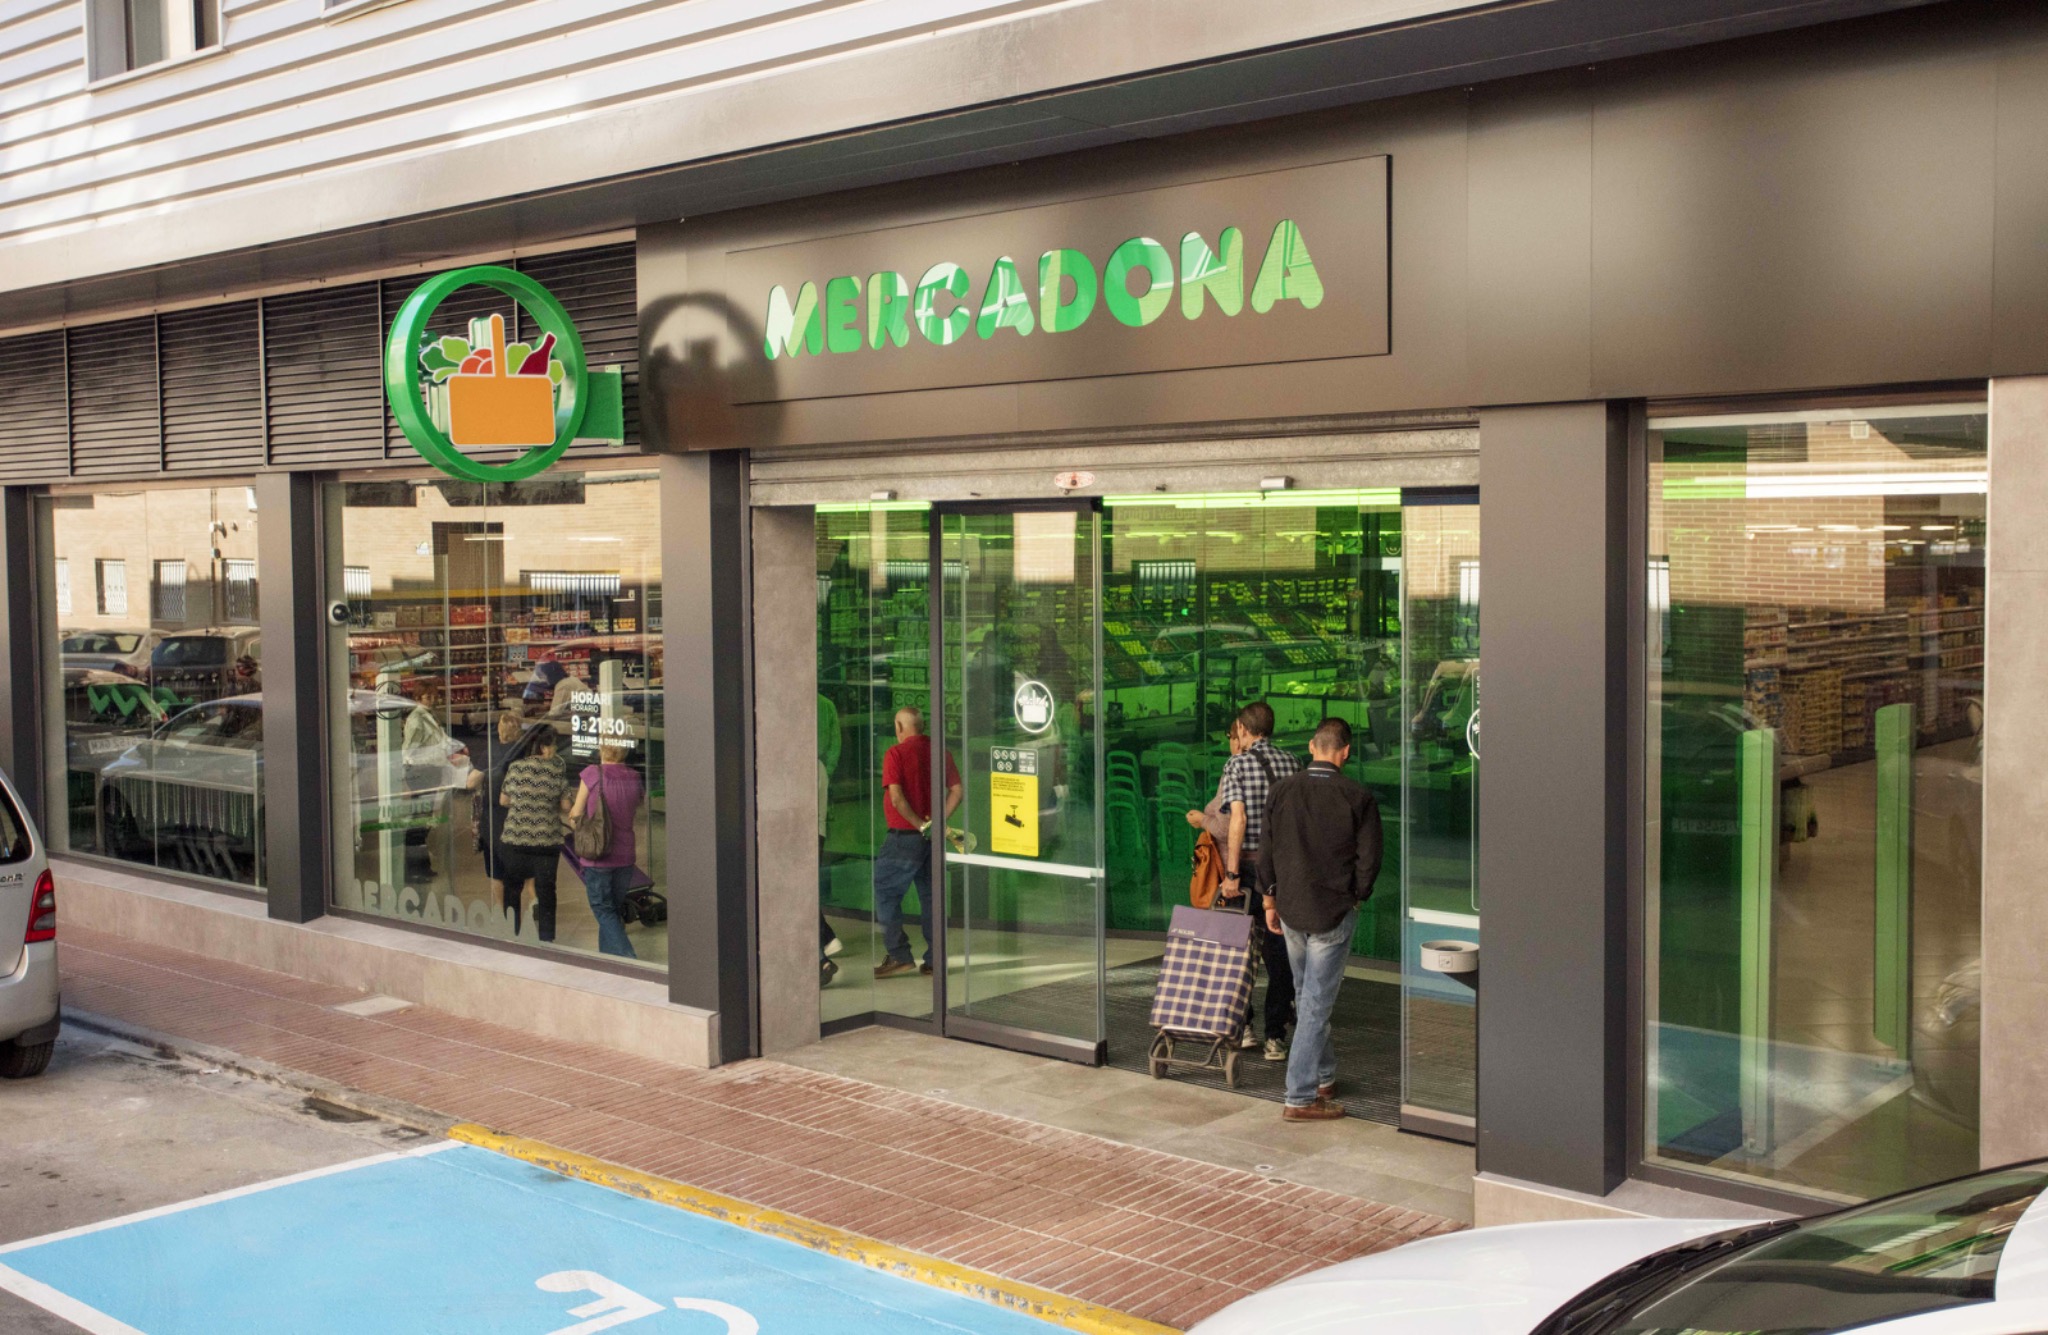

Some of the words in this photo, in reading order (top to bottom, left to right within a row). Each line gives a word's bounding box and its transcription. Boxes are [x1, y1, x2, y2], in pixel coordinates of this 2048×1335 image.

[764, 219, 1324, 360] MERCADONA
[571, 703, 599, 713] HORARIO
[571, 714, 581, 732] 9
